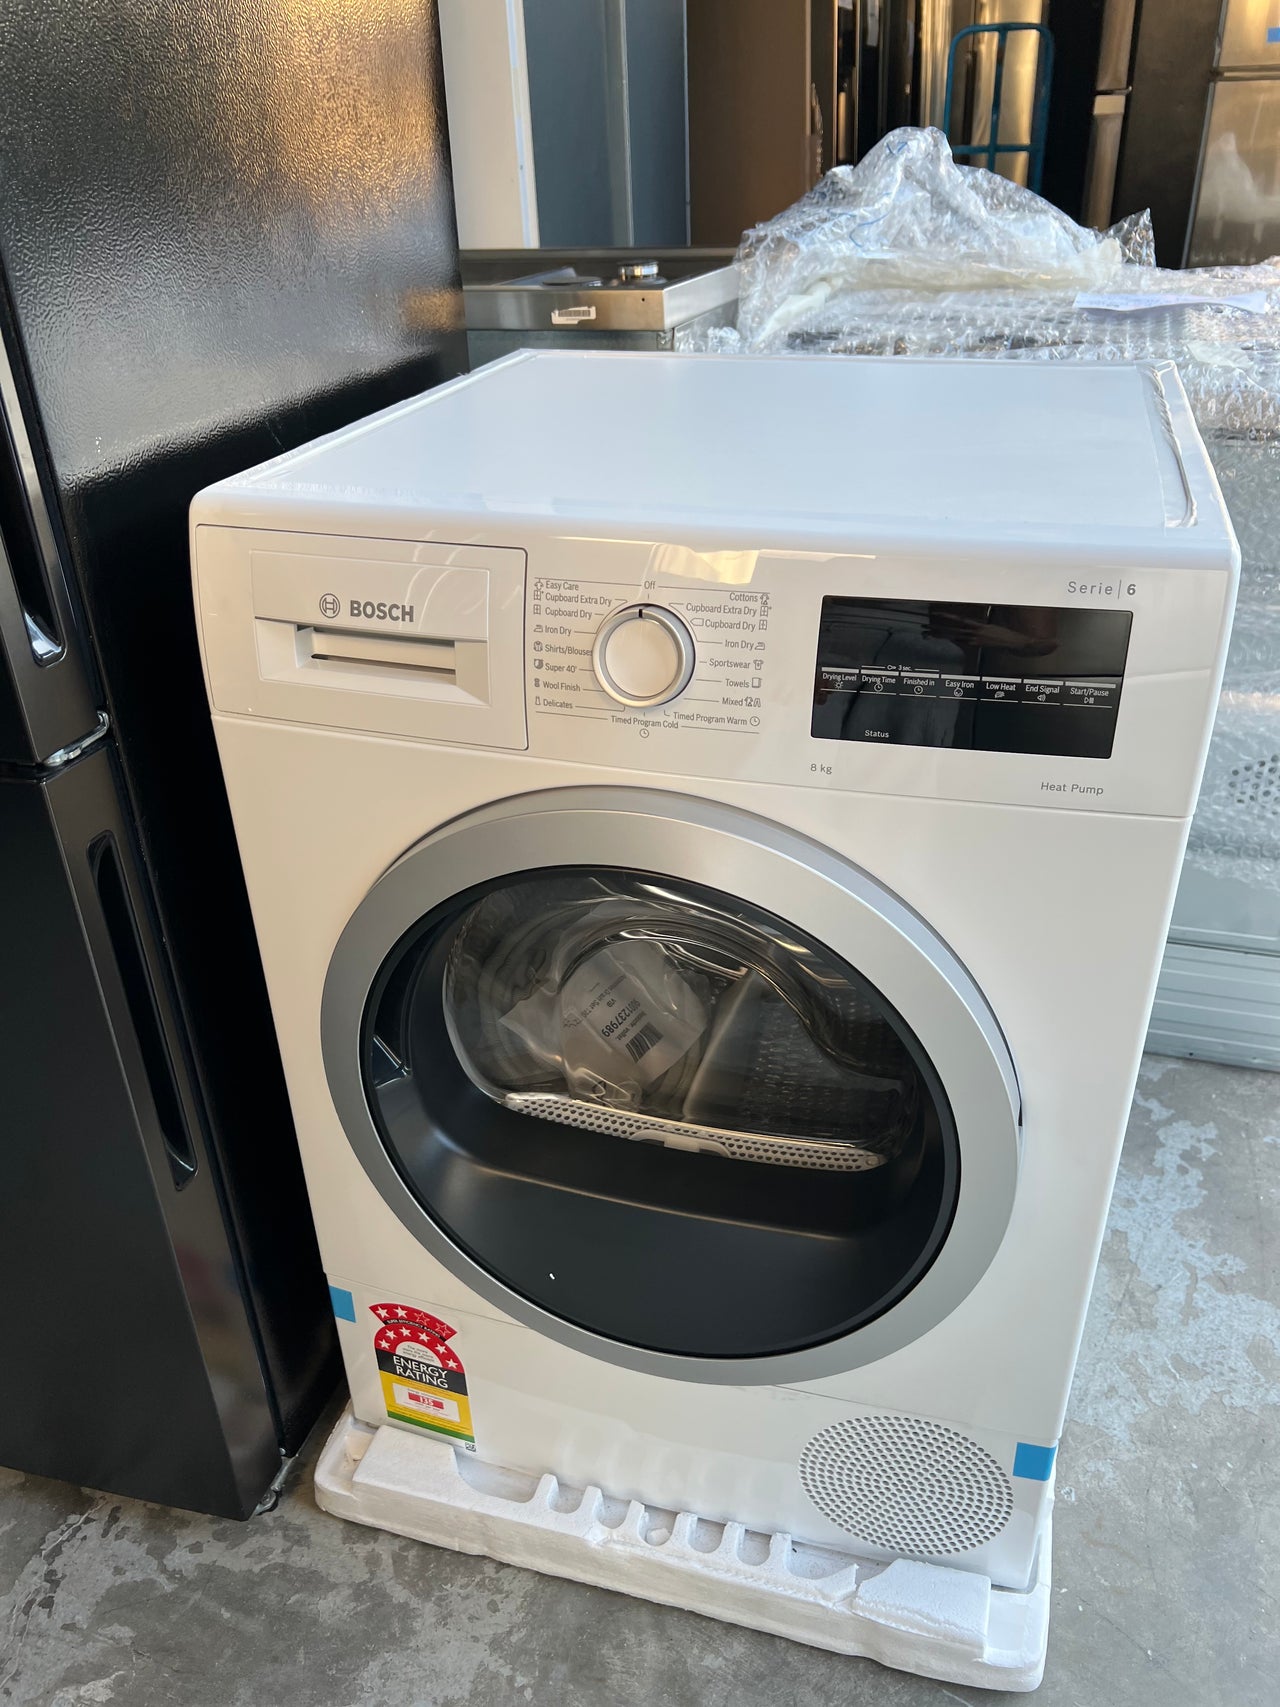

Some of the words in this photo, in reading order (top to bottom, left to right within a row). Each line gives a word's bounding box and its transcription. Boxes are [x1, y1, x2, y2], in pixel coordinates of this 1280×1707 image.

[546, 581, 562, 590] Easy
[563, 582, 579, 590] Care
[644, 581, 656, 589] Off
[1068, 580, 1112, 595] Serie
[1127, 584, 1136, 596] 6
[546, 592, 580, 604] Cupboard
[581, 596, 598, 604] Extra
[600, 596, 612, 606] Dry
[730, 592, 758, 602] Cottons
[350, 600, 414, 622] BOSCH
[545, 607, 578, 618] Cupboard
[580, 610, 592, 620] Dry
[686, 603, 722, 614] Cupboard
[723, 605, 742, 614] Extra
[743, 606, 757, 617] Dry
[545, 625, 558, 633] Iron
[560, 626, 571, 636] Dry
[705, 620, 740, 630] Cupboard
[742, 621, 755, 632] Dry
[725, 640, 739, 648] Iron
[741, 641, 754, 651] Dry
[545, 663, 565, 673] Super
[710, 659, 750, 669] Sportswear
[823, 673, 841, 681] Drying
[862, 676, 881, 684] Drying
[543, 681, 559, 690] Wool
[561, 683, 580, 692] Finish
[726, 679, 749, 688] Towels
[946, 680, 961, 688] Easy
[962, 681, 974, 689] Iron
[986, 682, 1000, 690] Low
[1000, 683, 1016, 691] Heat
[1041, 686, 1059, 694] Signal
[1070, 687, 1109, 696] Start/Pause
[544, 699, 572, 708] Delicates
[722, 697, 743, 706] Mixed
[612, 715, 632, 724] Timed
[632, 718, 661, 728] Program
[663, 720, 678, 728] Cold
[674, 712, 694, 720] Timed
[696, 713, 726, 723] Program
[727, 716, 747, 725] Warm
[865, 730, 889, 738] Status
[811, 764, 817, 772] 8
[821, 764, 832, 774] kg
[1041, 782, 1066, 792] Heat
[1071, 784, 1103, 796] Pump
[393, 1356, 447, 1378] ENERGY
[396, 1366, 448, 1388] RATING
[420, 1396, 434, 1406] 135
